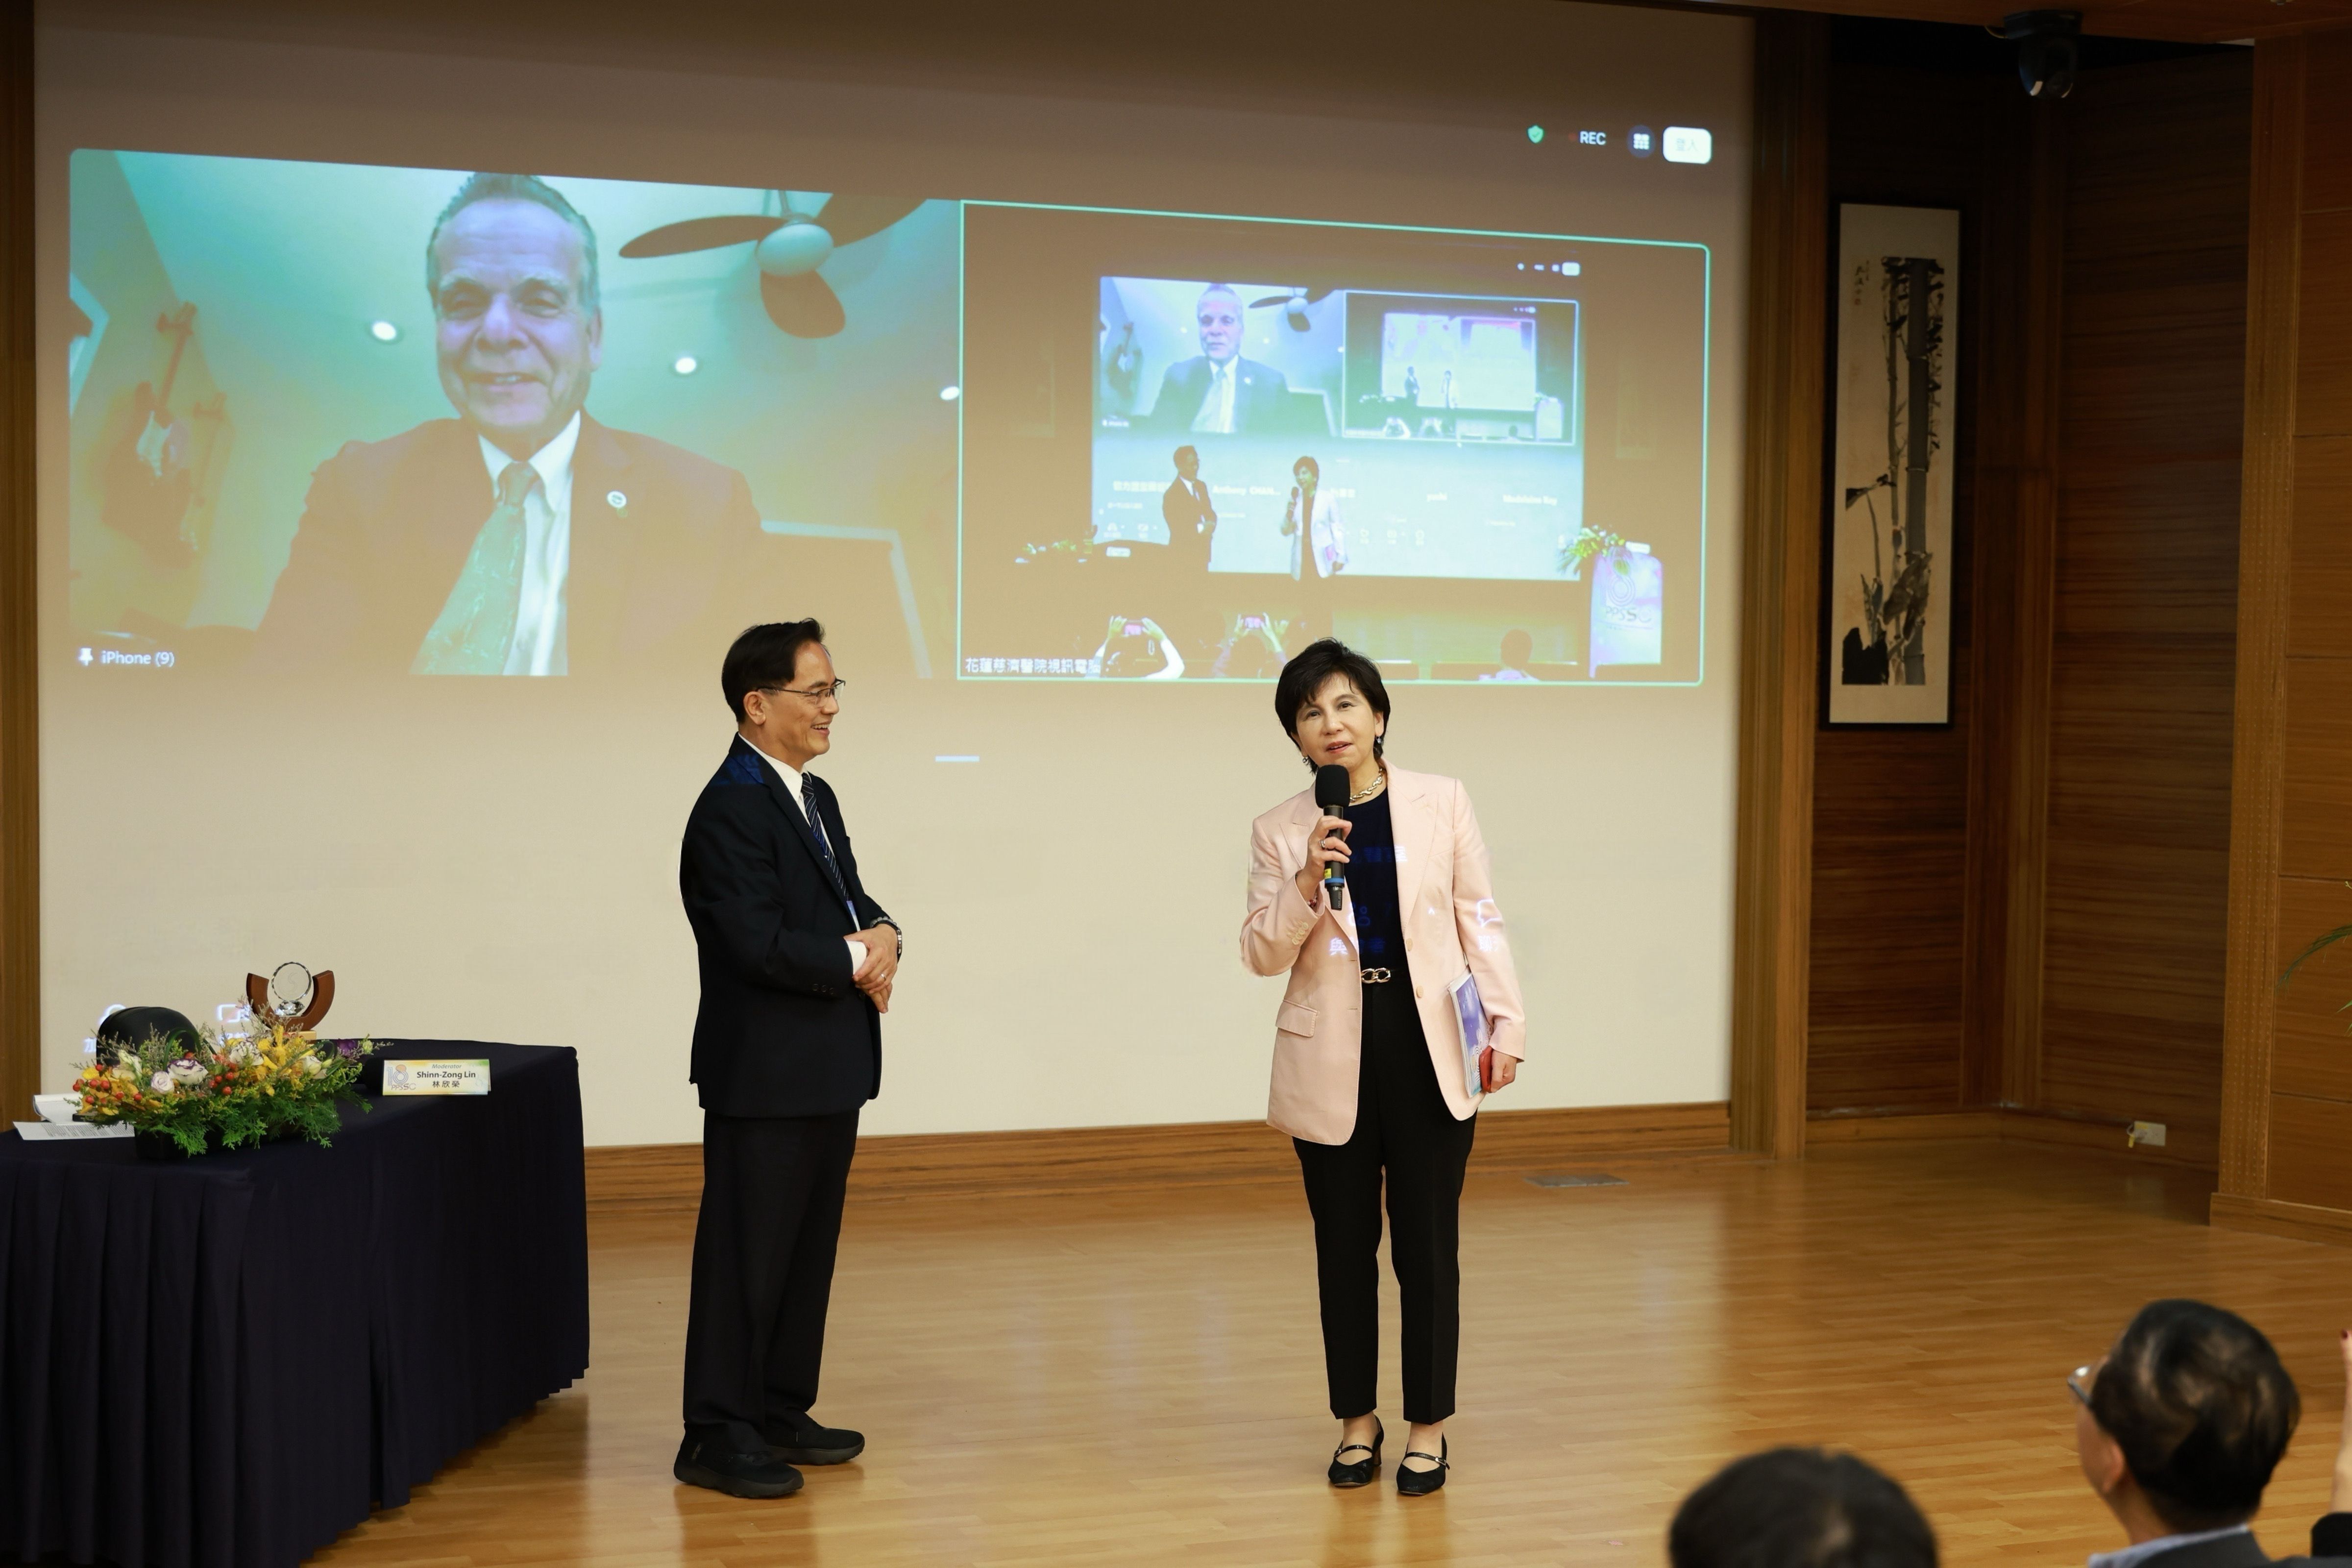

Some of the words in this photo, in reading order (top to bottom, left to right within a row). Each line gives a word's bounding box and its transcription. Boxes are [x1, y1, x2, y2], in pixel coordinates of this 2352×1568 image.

[1579, 131, 1606, 145] REC
[101, 650, 151, 664] iPhone
[155, 652, 175, 667] (9)
[416, 1071, 463, 1079] Shinn-Zong
